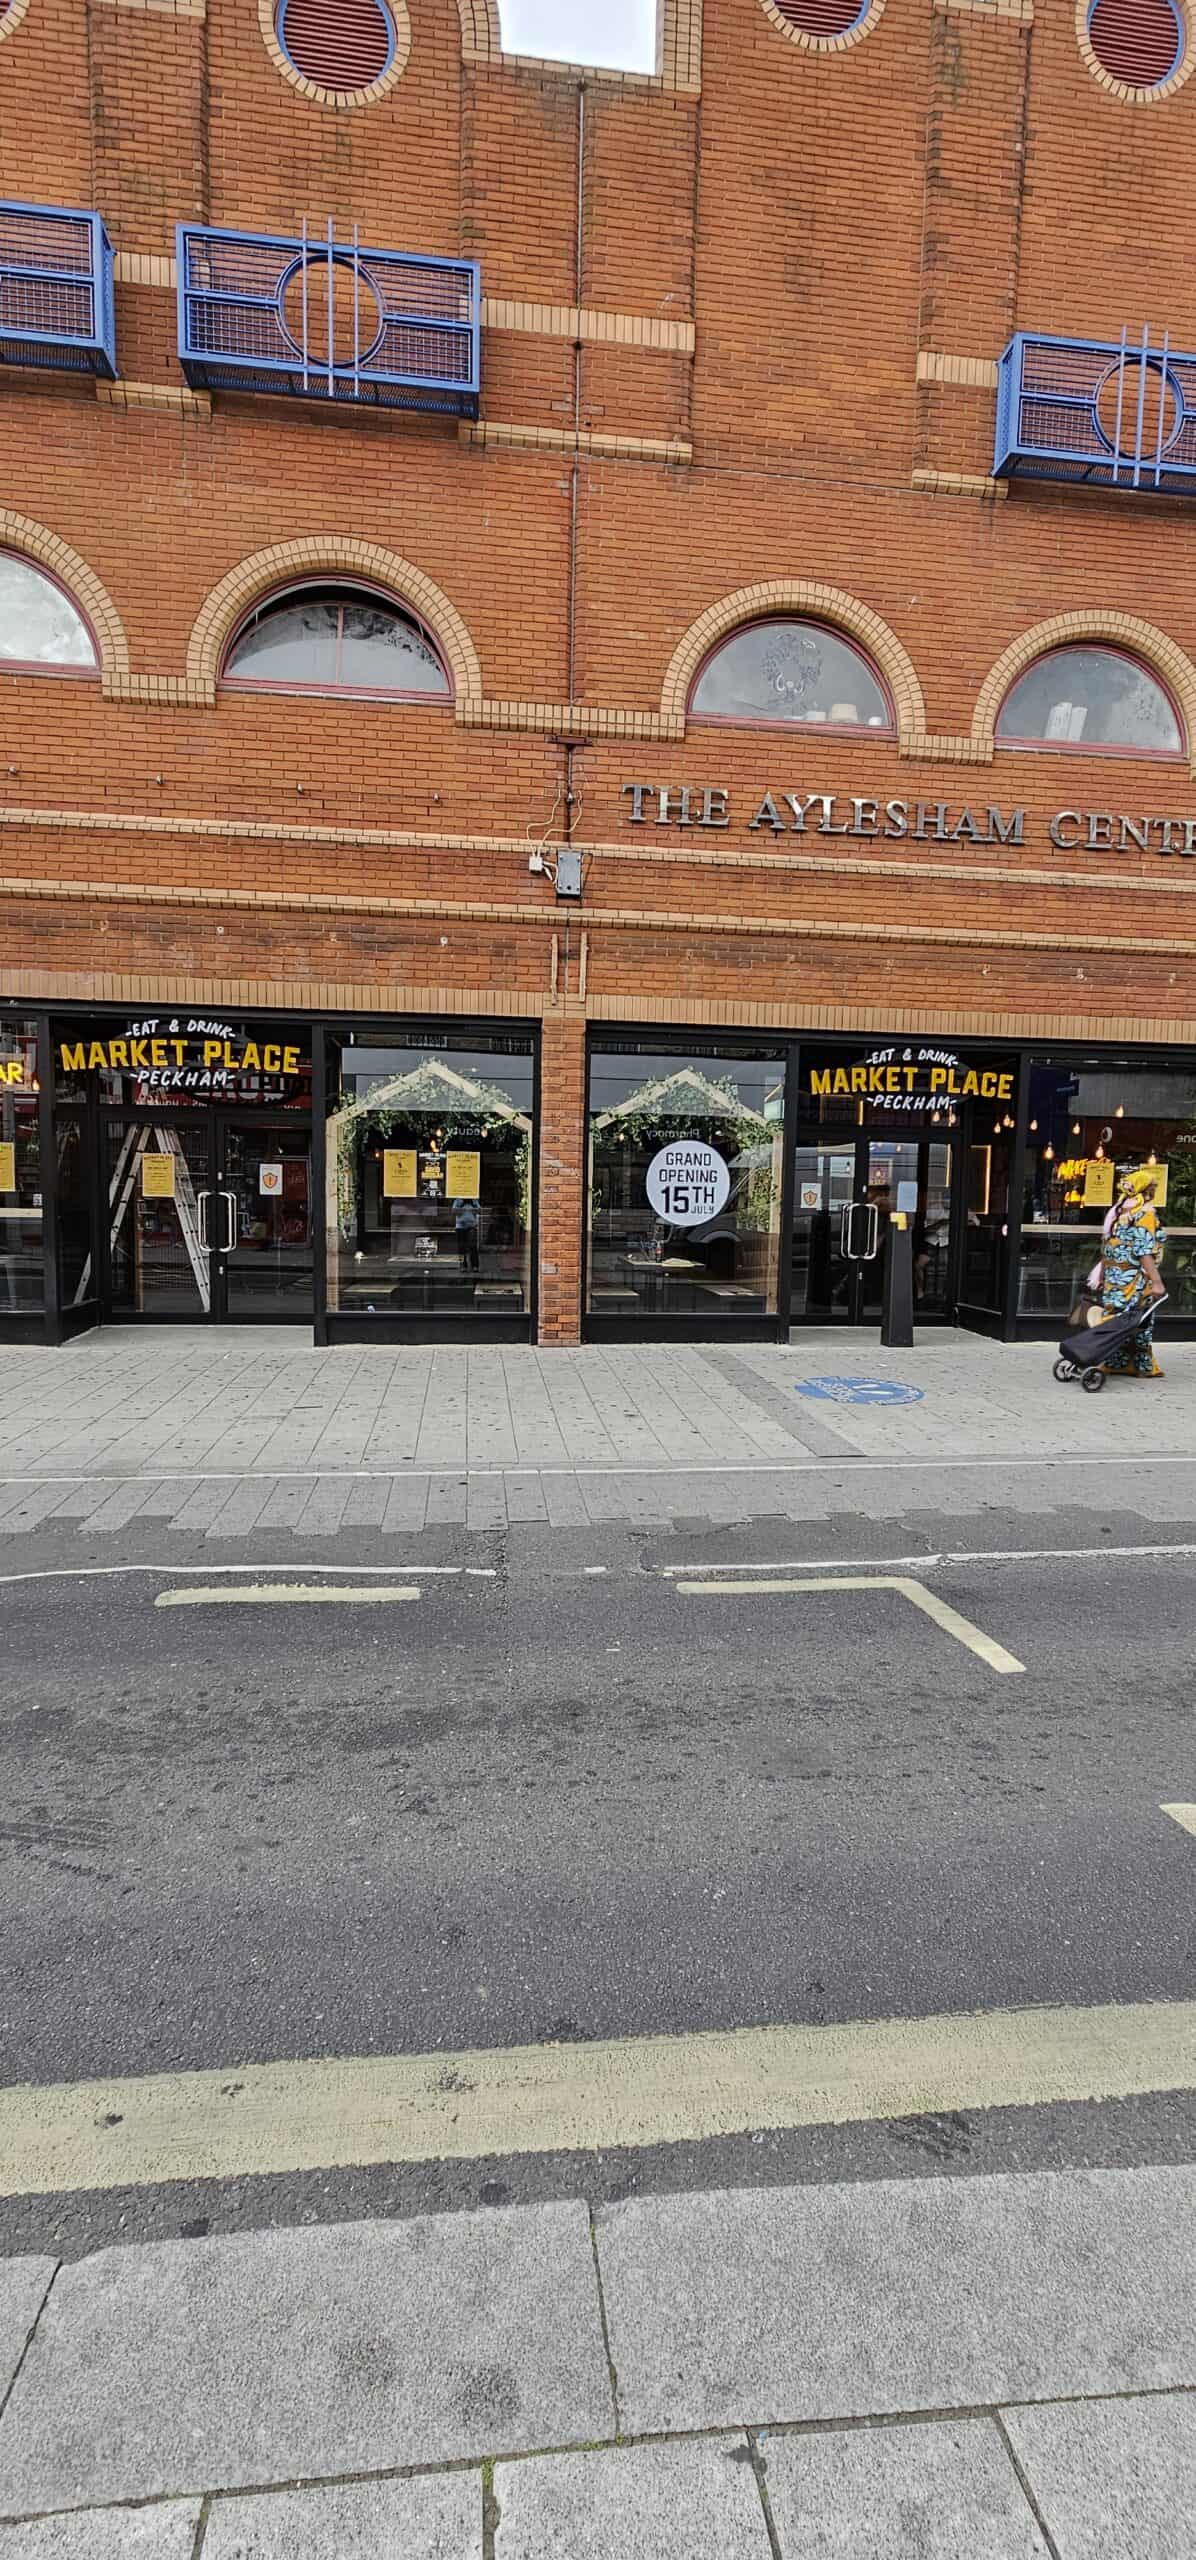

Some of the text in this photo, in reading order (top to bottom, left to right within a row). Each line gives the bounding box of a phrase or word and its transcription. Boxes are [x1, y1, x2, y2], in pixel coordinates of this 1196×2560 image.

[622, 783, 730, 827] THE
[748, 792, 1027, 846] AYLESHAM
[169, 1019, 180, 1033] &
[60, 1039, 300, 1074] MARKET PLACE
[902, 1048, 912, 1061] &
[810, 1066, 1014, 1099] MARKET PLACE
[665, 1152, 712, 1166] GRAND
[659, 1169, 718, 1183] OPENING
[661, 1186, 715, 1214] 15TH
[690, 1205, 715, 1215] JULY
